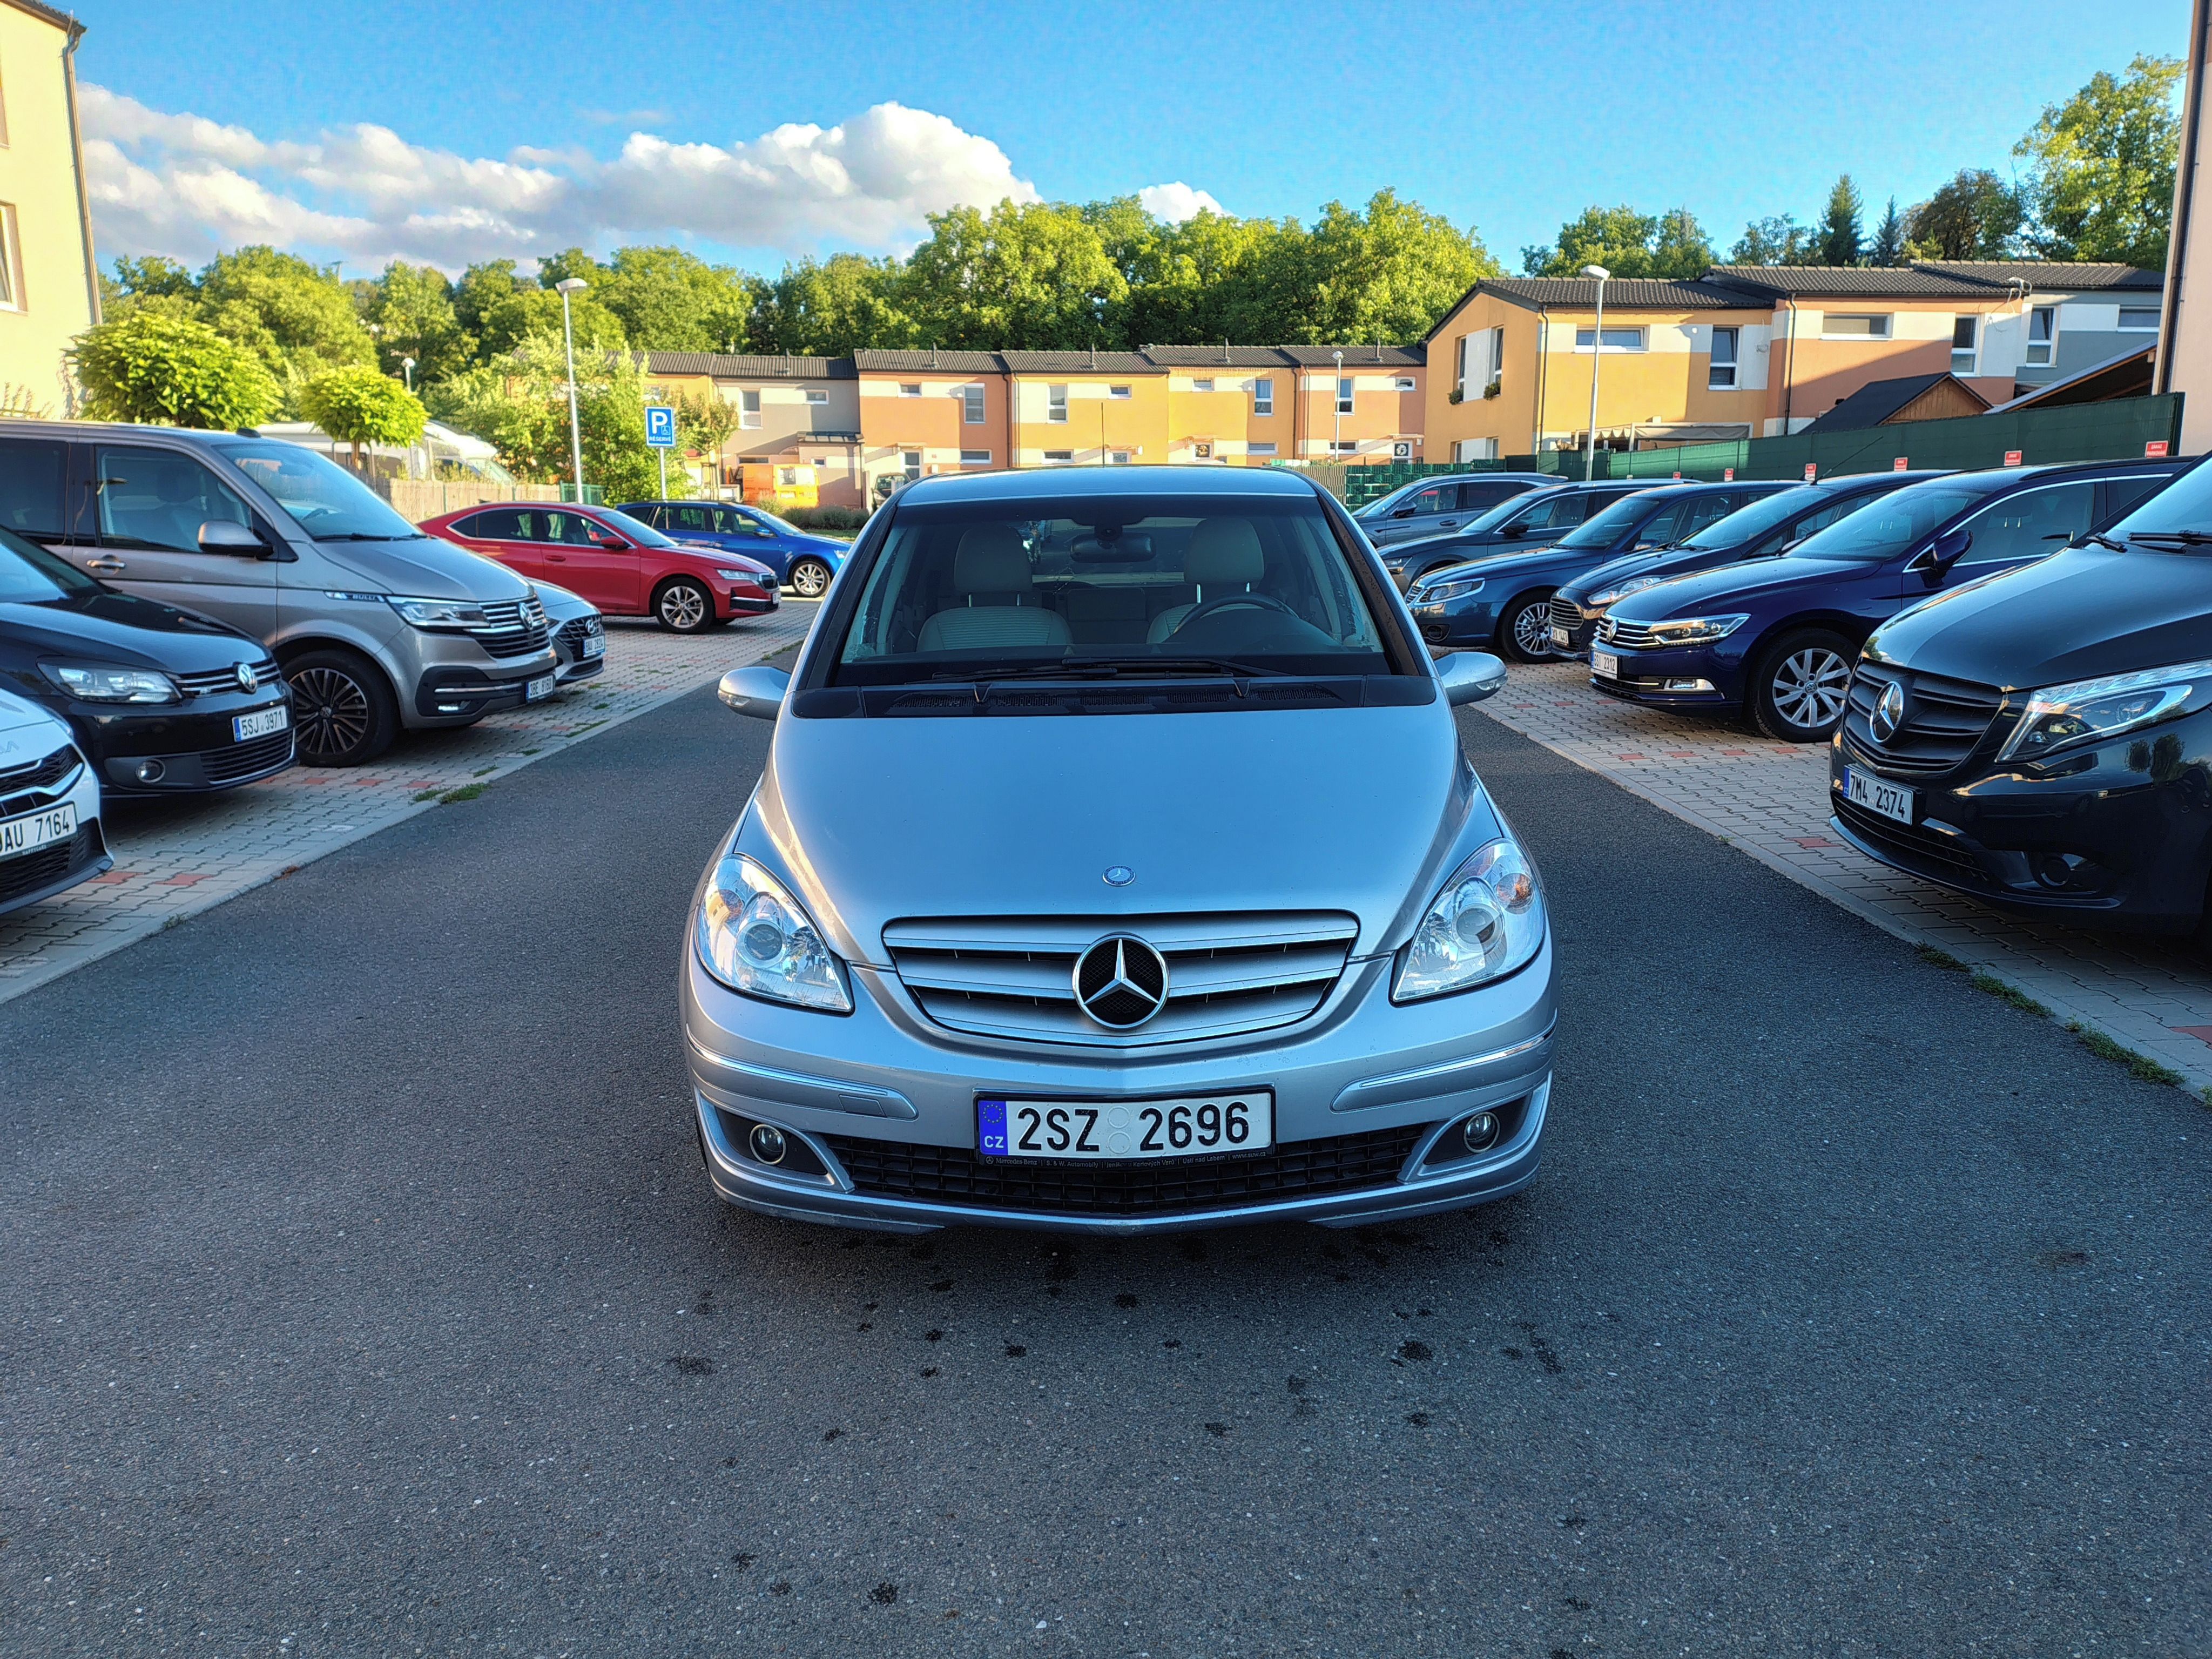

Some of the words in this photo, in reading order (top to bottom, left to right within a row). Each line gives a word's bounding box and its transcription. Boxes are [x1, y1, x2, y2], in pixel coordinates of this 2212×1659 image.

[651, 411, 667, 434] P
[1604, 656, 1615, 671] 2312
[241, 716, 259, 736] 5SJ
[265, 710, 283, 730] 3971
[1850, 774, 1868, 804] 7M4
[1876, 785, 1905, 818] 2374
[0, 823, 23, 852] AU
[35, 810, 70, 842] 7164
[1017, 1108, 1100, 1152] 2SZ
[1138, 1101, 1249, 1151] 2696
[984, 1136, 1004, 1149] CZ
